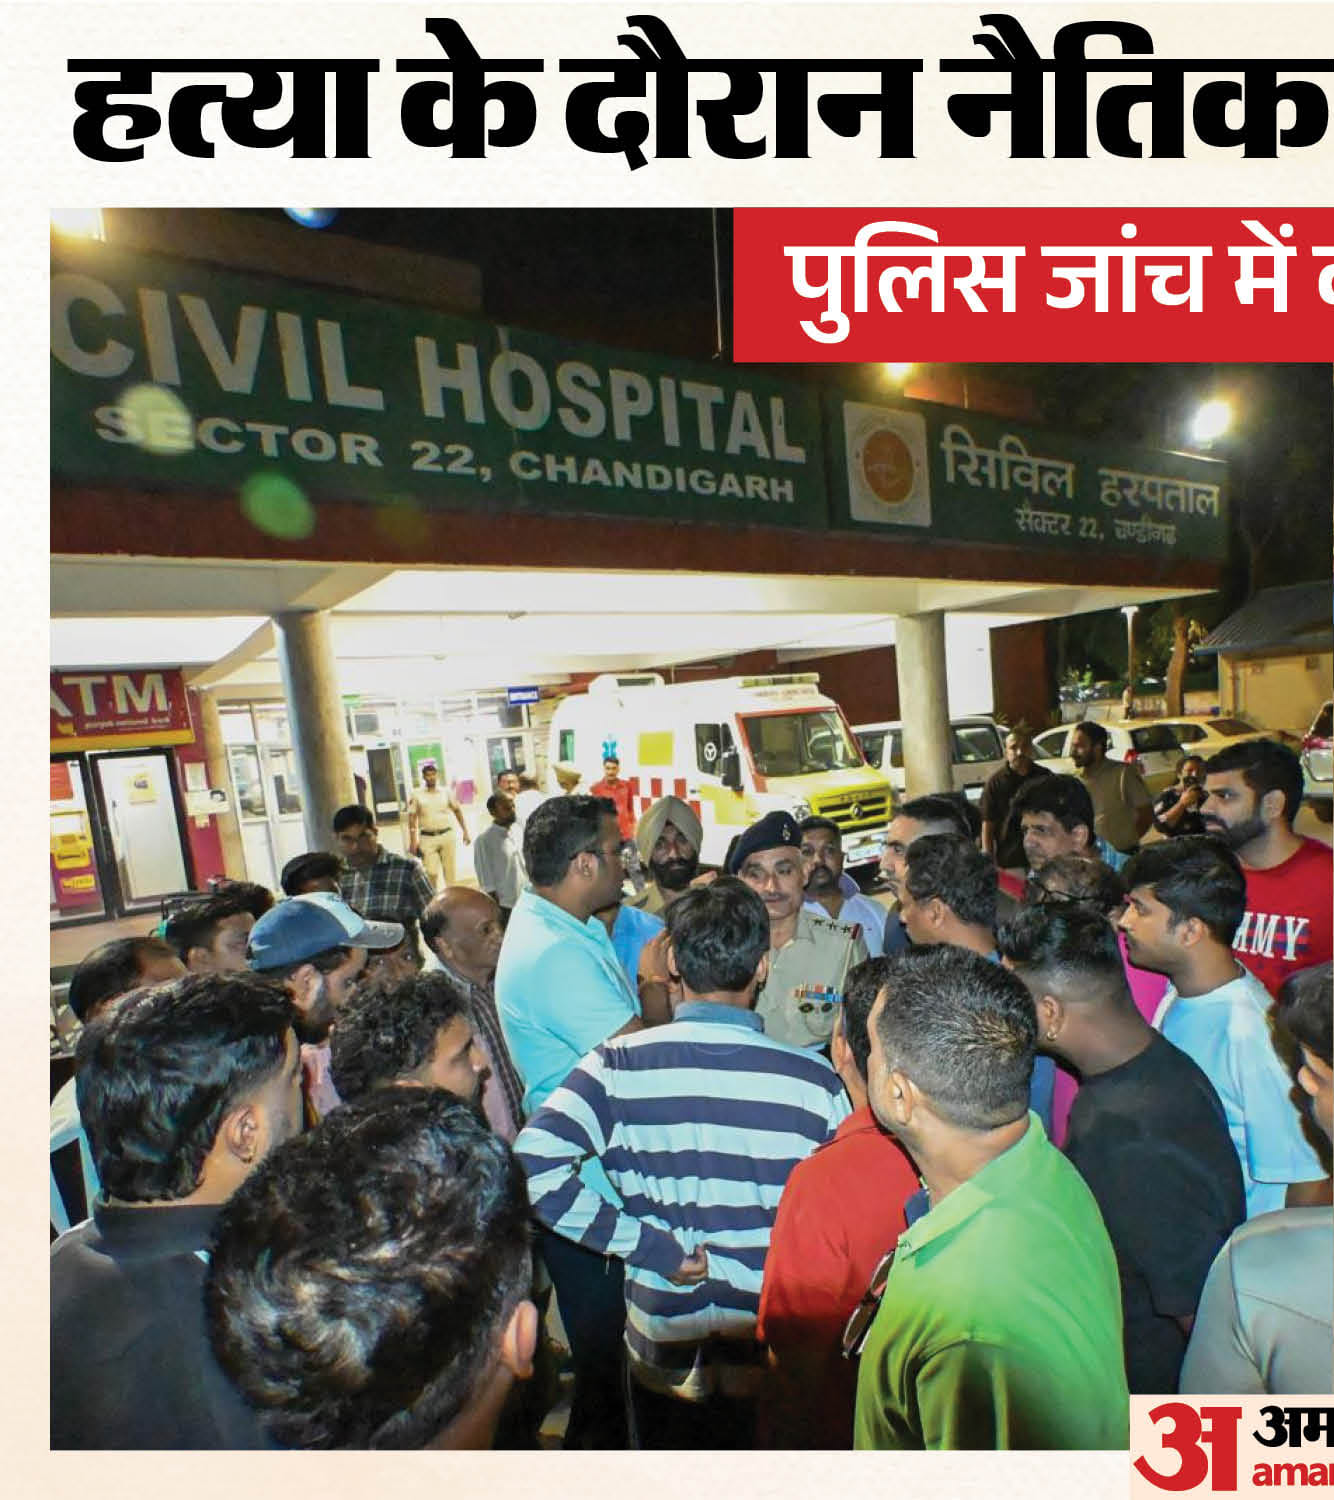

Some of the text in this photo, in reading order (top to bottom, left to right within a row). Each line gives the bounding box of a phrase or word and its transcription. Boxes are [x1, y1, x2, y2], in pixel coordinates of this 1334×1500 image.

[50, 272, 807, 465] CIVIL HOSPITAL
[95, 406, 795, 503] SECTOR 22, CHANDIGARH
[940, 423, 1076, 499] सिविल
[1231, 911, 1310, 961] MMY
